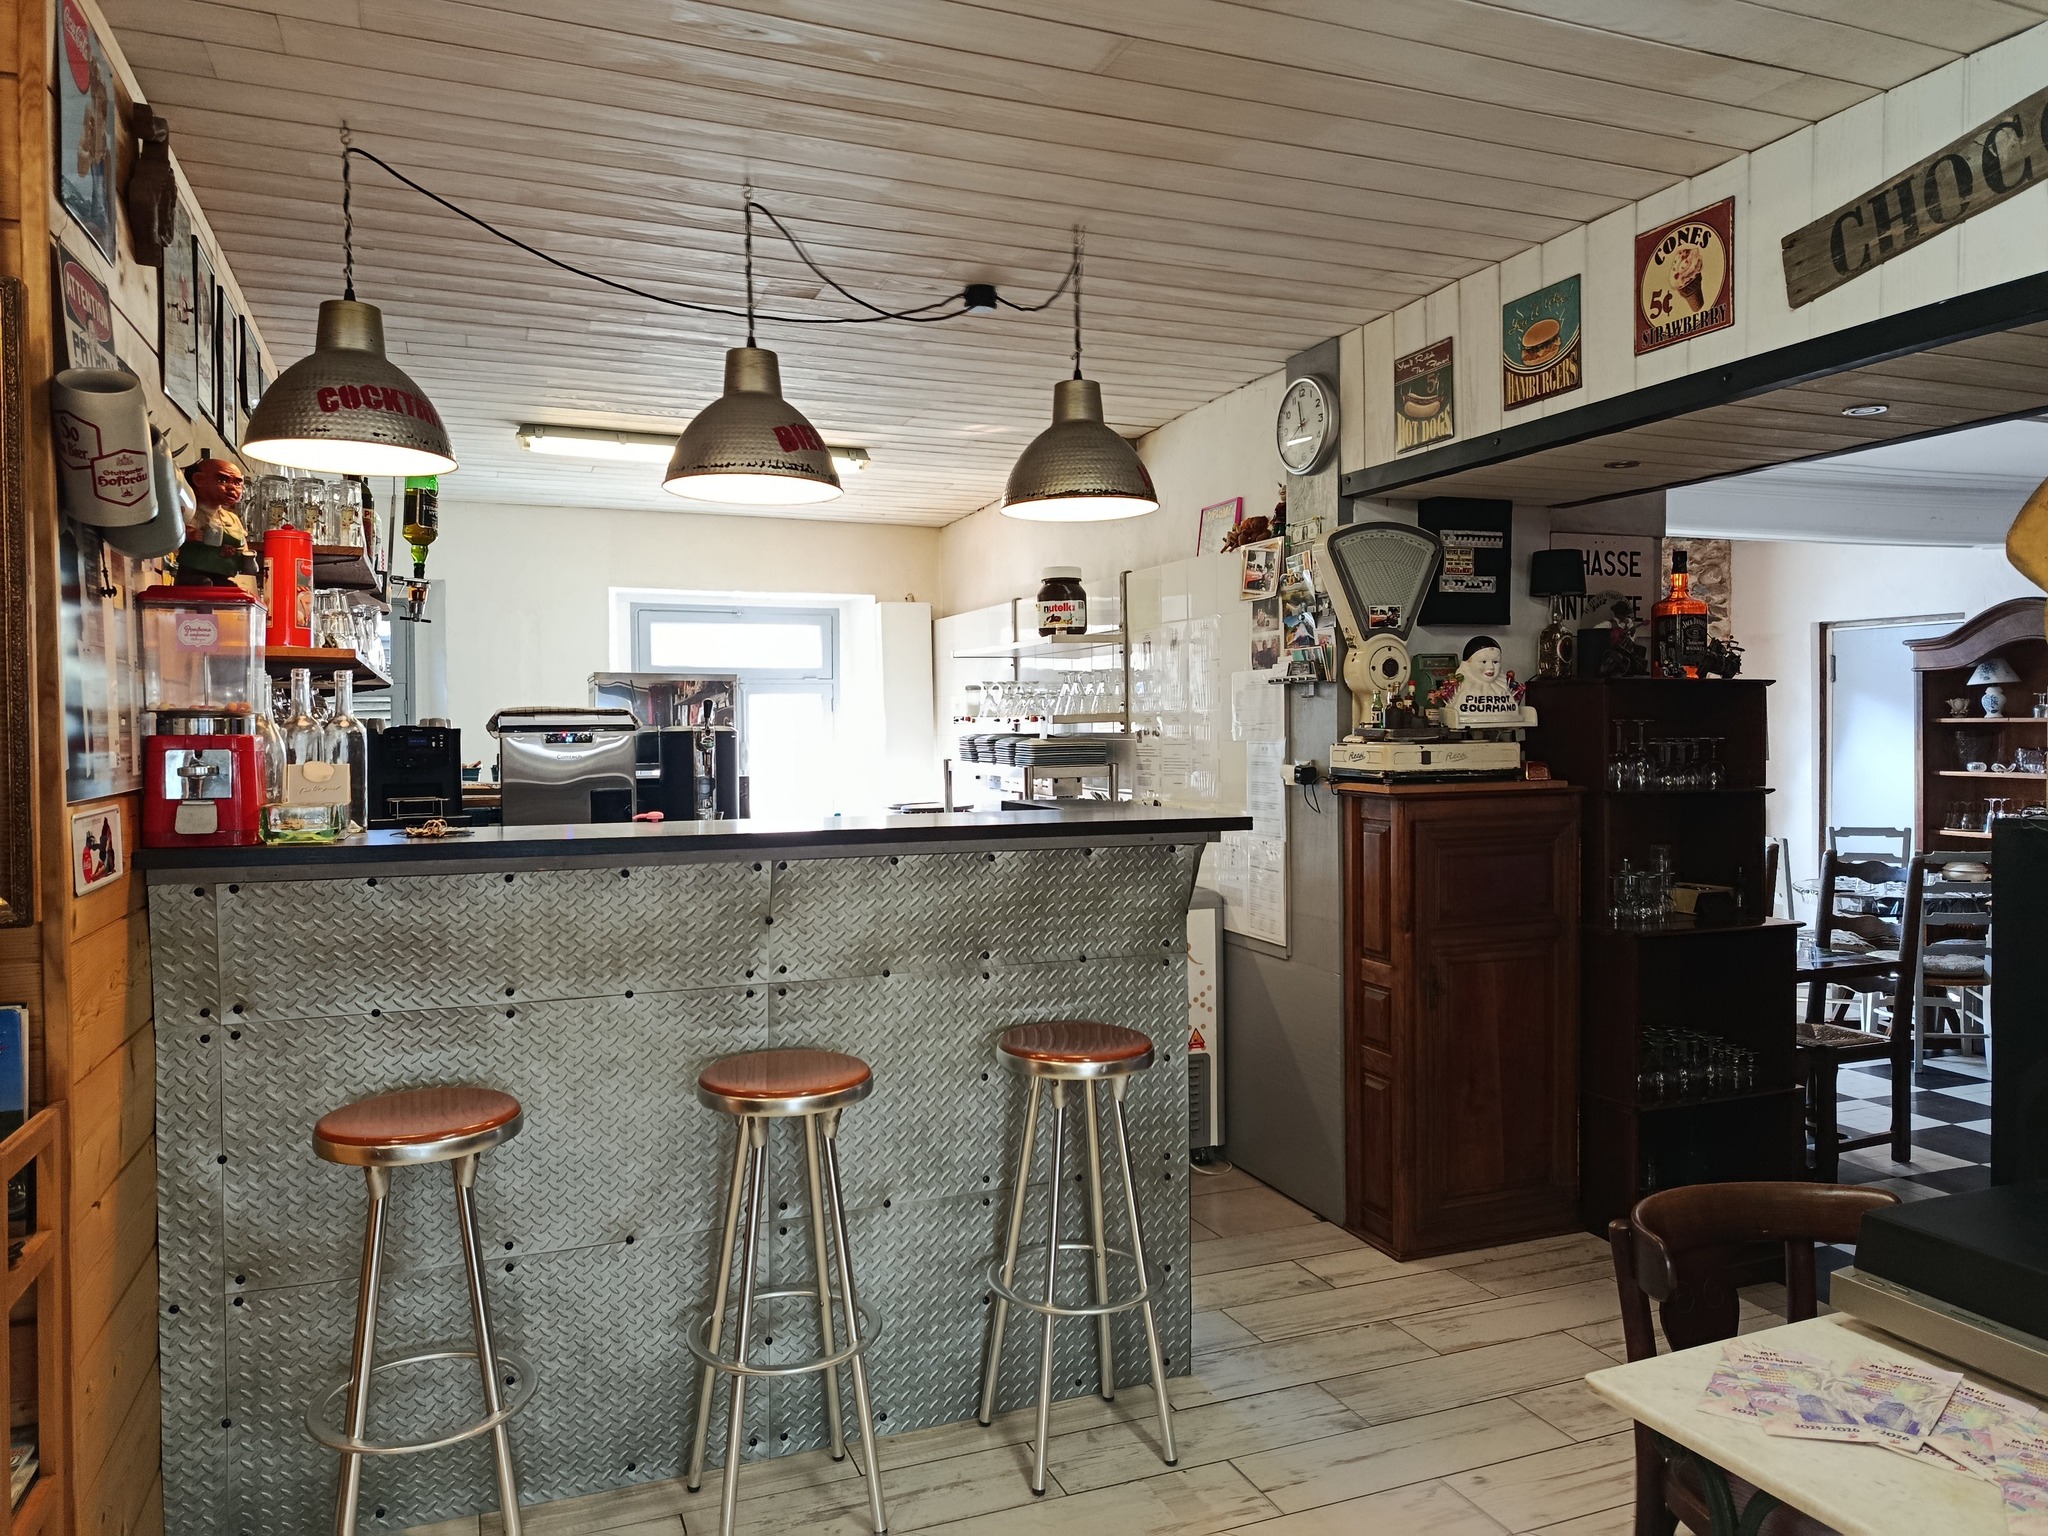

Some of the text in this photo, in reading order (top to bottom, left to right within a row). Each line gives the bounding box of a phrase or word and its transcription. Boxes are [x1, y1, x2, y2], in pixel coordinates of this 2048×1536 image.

[1654, 227, 1711, 266] CONES
[66, 270, 109, 331] ATTENTION
[1650, 289, 1673, 320] 5¢
[1641, 303, 1727, 348] STRAWBERRY
[1506, 351, 1579, 405] HAMBURGERS
[1315, 398, 1321, 408] 2
[1318, 413, 1324, 422] 3
[1397, 403, 1452, 448] HOT DOGS
[103, 467, 144, 477] Stuttgarter
[98, 473, 148, 488] Hofbräu
[1583, 551, 1641, 578] HASSE
[1044, 602, 1076, 613] nutella
[1465, 695, 1510, 704] PIERROT
[1460, 703, 1517, 713] GOURMAND
[1831, 1424, 1860, 1433] 2026
[1880, 1428, 1910, 1441] 2026
